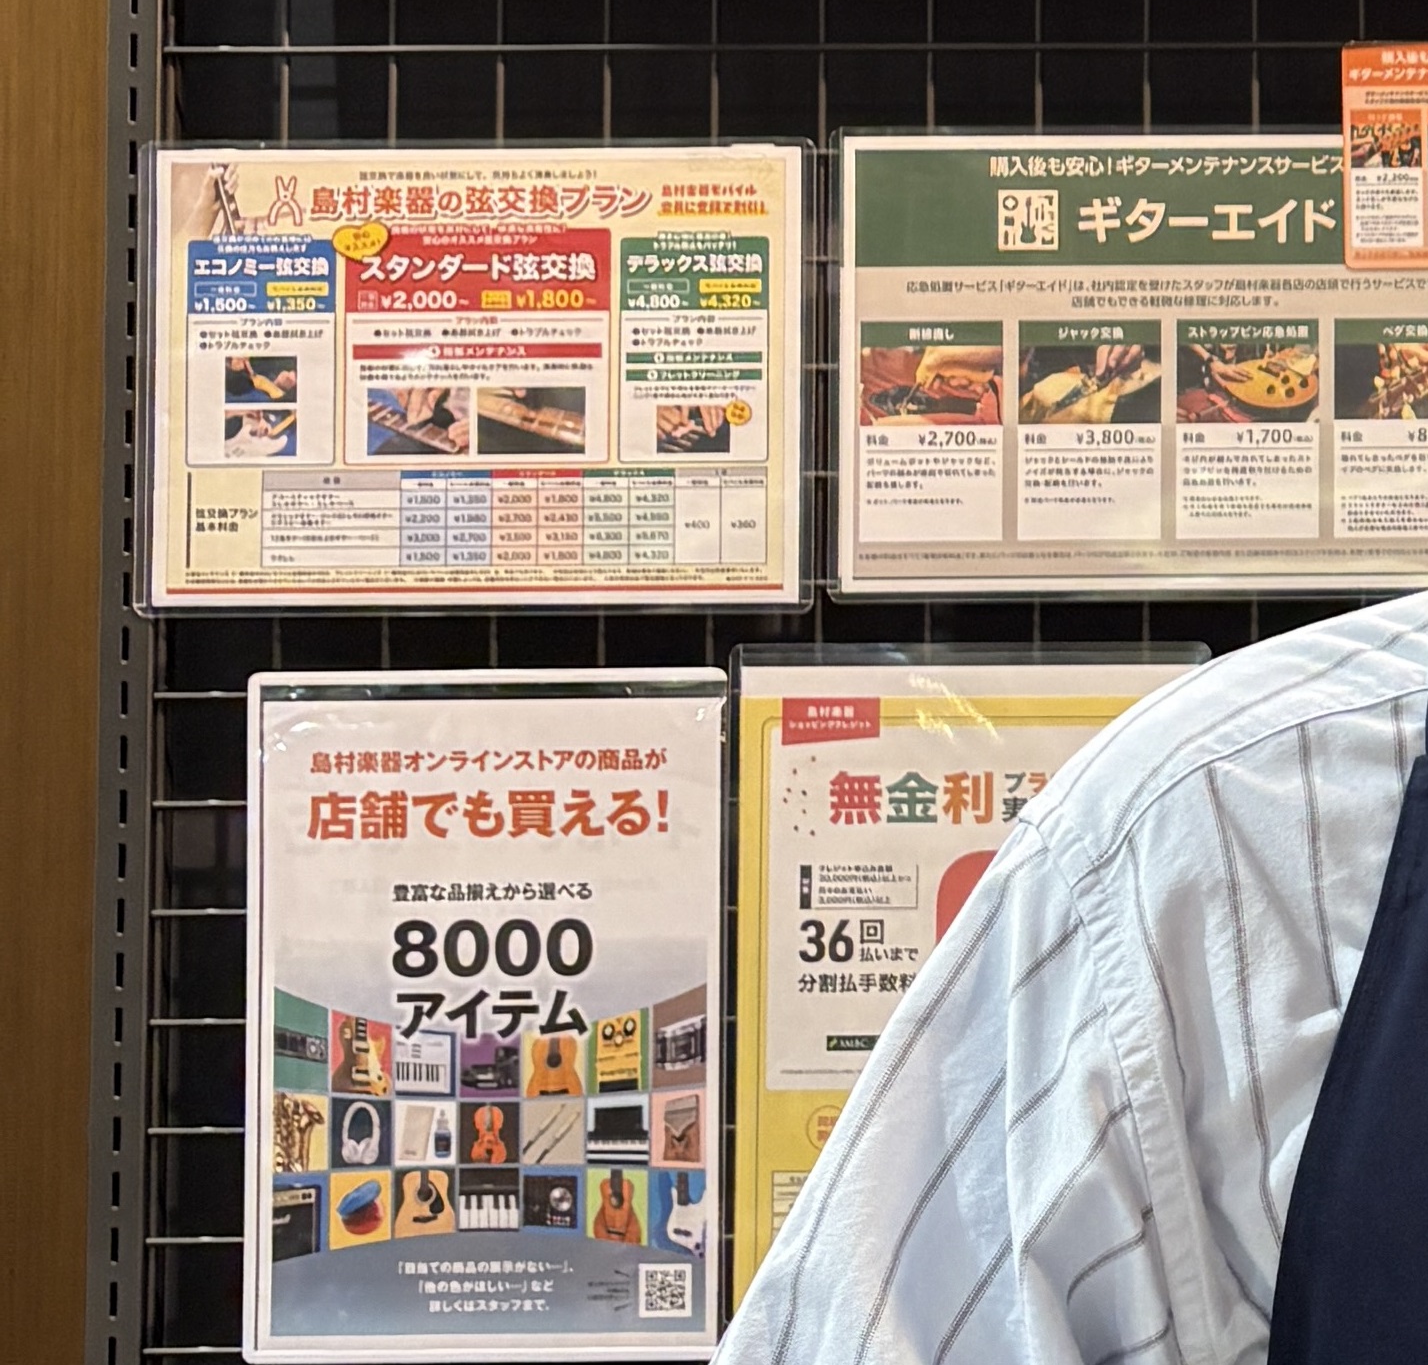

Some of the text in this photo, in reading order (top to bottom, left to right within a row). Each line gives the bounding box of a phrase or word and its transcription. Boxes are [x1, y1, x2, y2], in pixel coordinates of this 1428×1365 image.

[310, 183, 652, 218] 島村楽器の弦交換プラン
[1077, 196, 1338, 244] ギターエイド
[193, 257, 330, 278] エコノミー弦交換
[359, 252, 598, 282] スタンダード弦交換
[626, 252, 763, 274] デラックス弦交換
[309, 747, 667, 775] 島村楽器オンラインストアの商品が
[828, 769, 995, 826] 無金利
[306, 787, 670, 841] 店舗でも買える！
[391, 881, 594, 903] 豊富な品揃えから選べる
[798, 918, 855, 965] 36
[859, 919, 885, 945] 回
[391, 918, 595, 979] 8000
[859, 947, 920, 963] 払いまで
[396, 989, 589, 1040] アイテム
